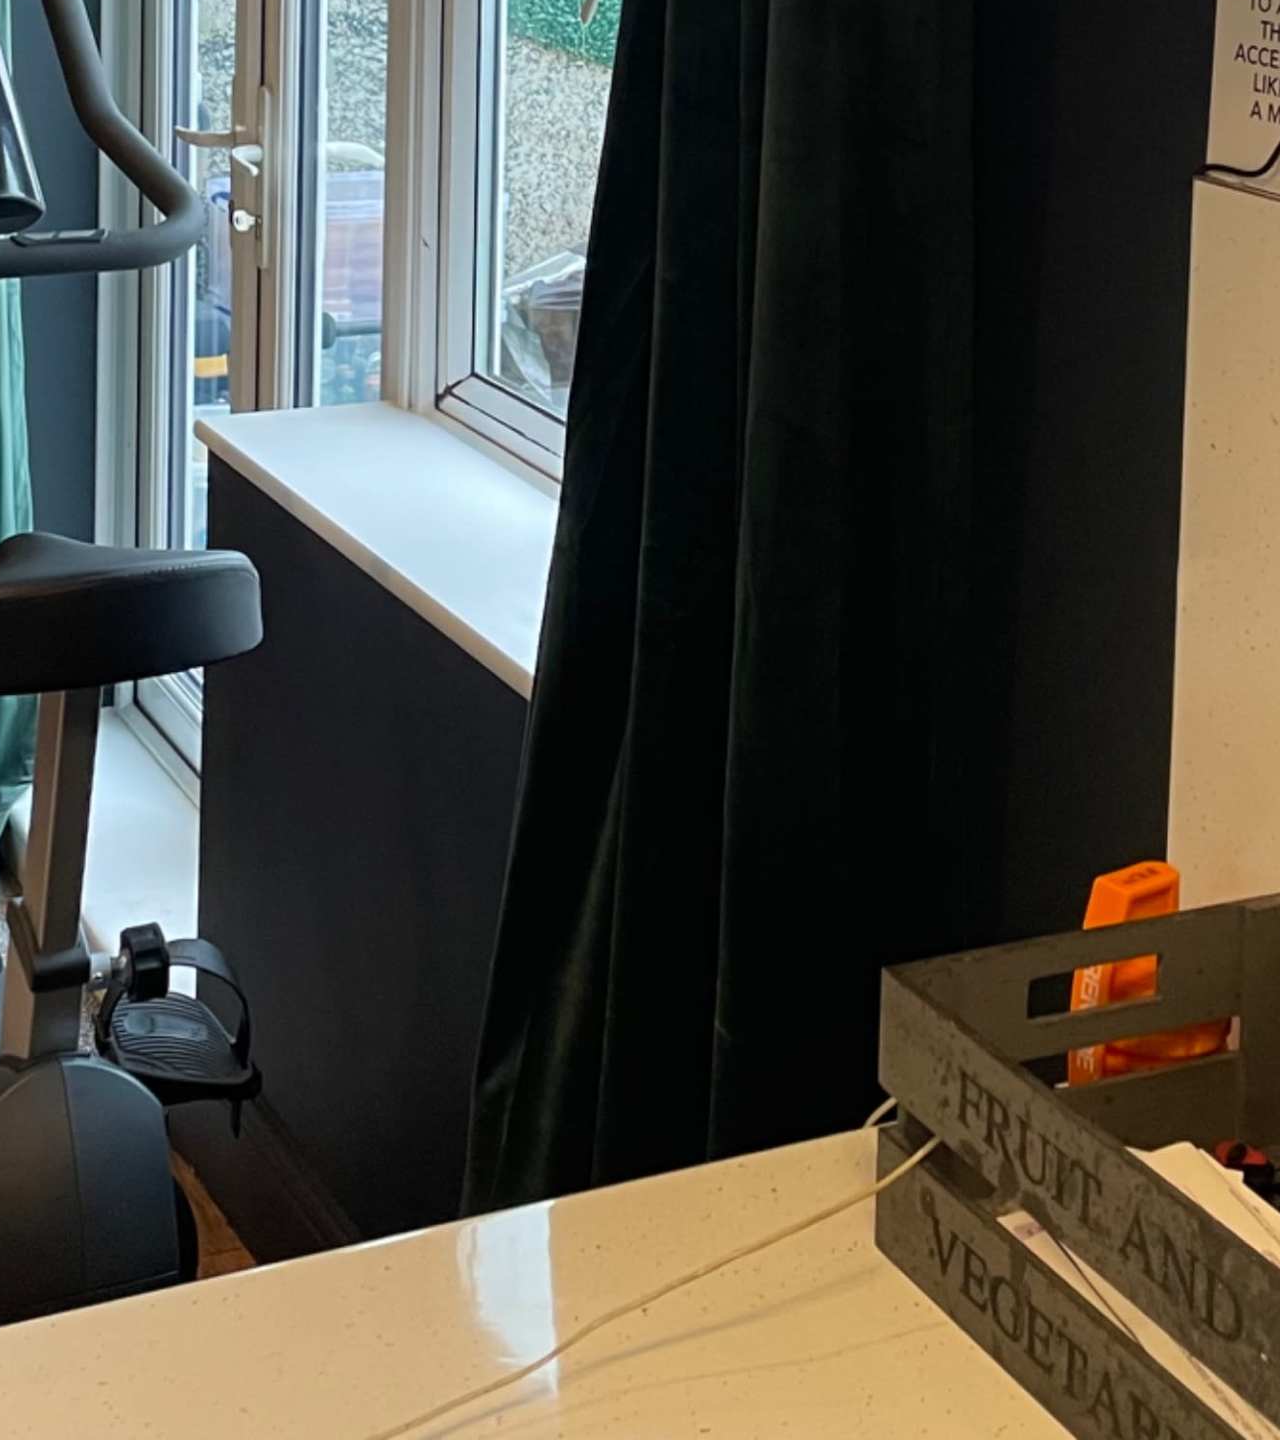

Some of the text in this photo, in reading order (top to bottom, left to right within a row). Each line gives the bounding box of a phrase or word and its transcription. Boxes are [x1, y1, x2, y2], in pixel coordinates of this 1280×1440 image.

[1250, 101, 1263, 120] A
[956, 1069, 1243, 1342] FRUIT AND
